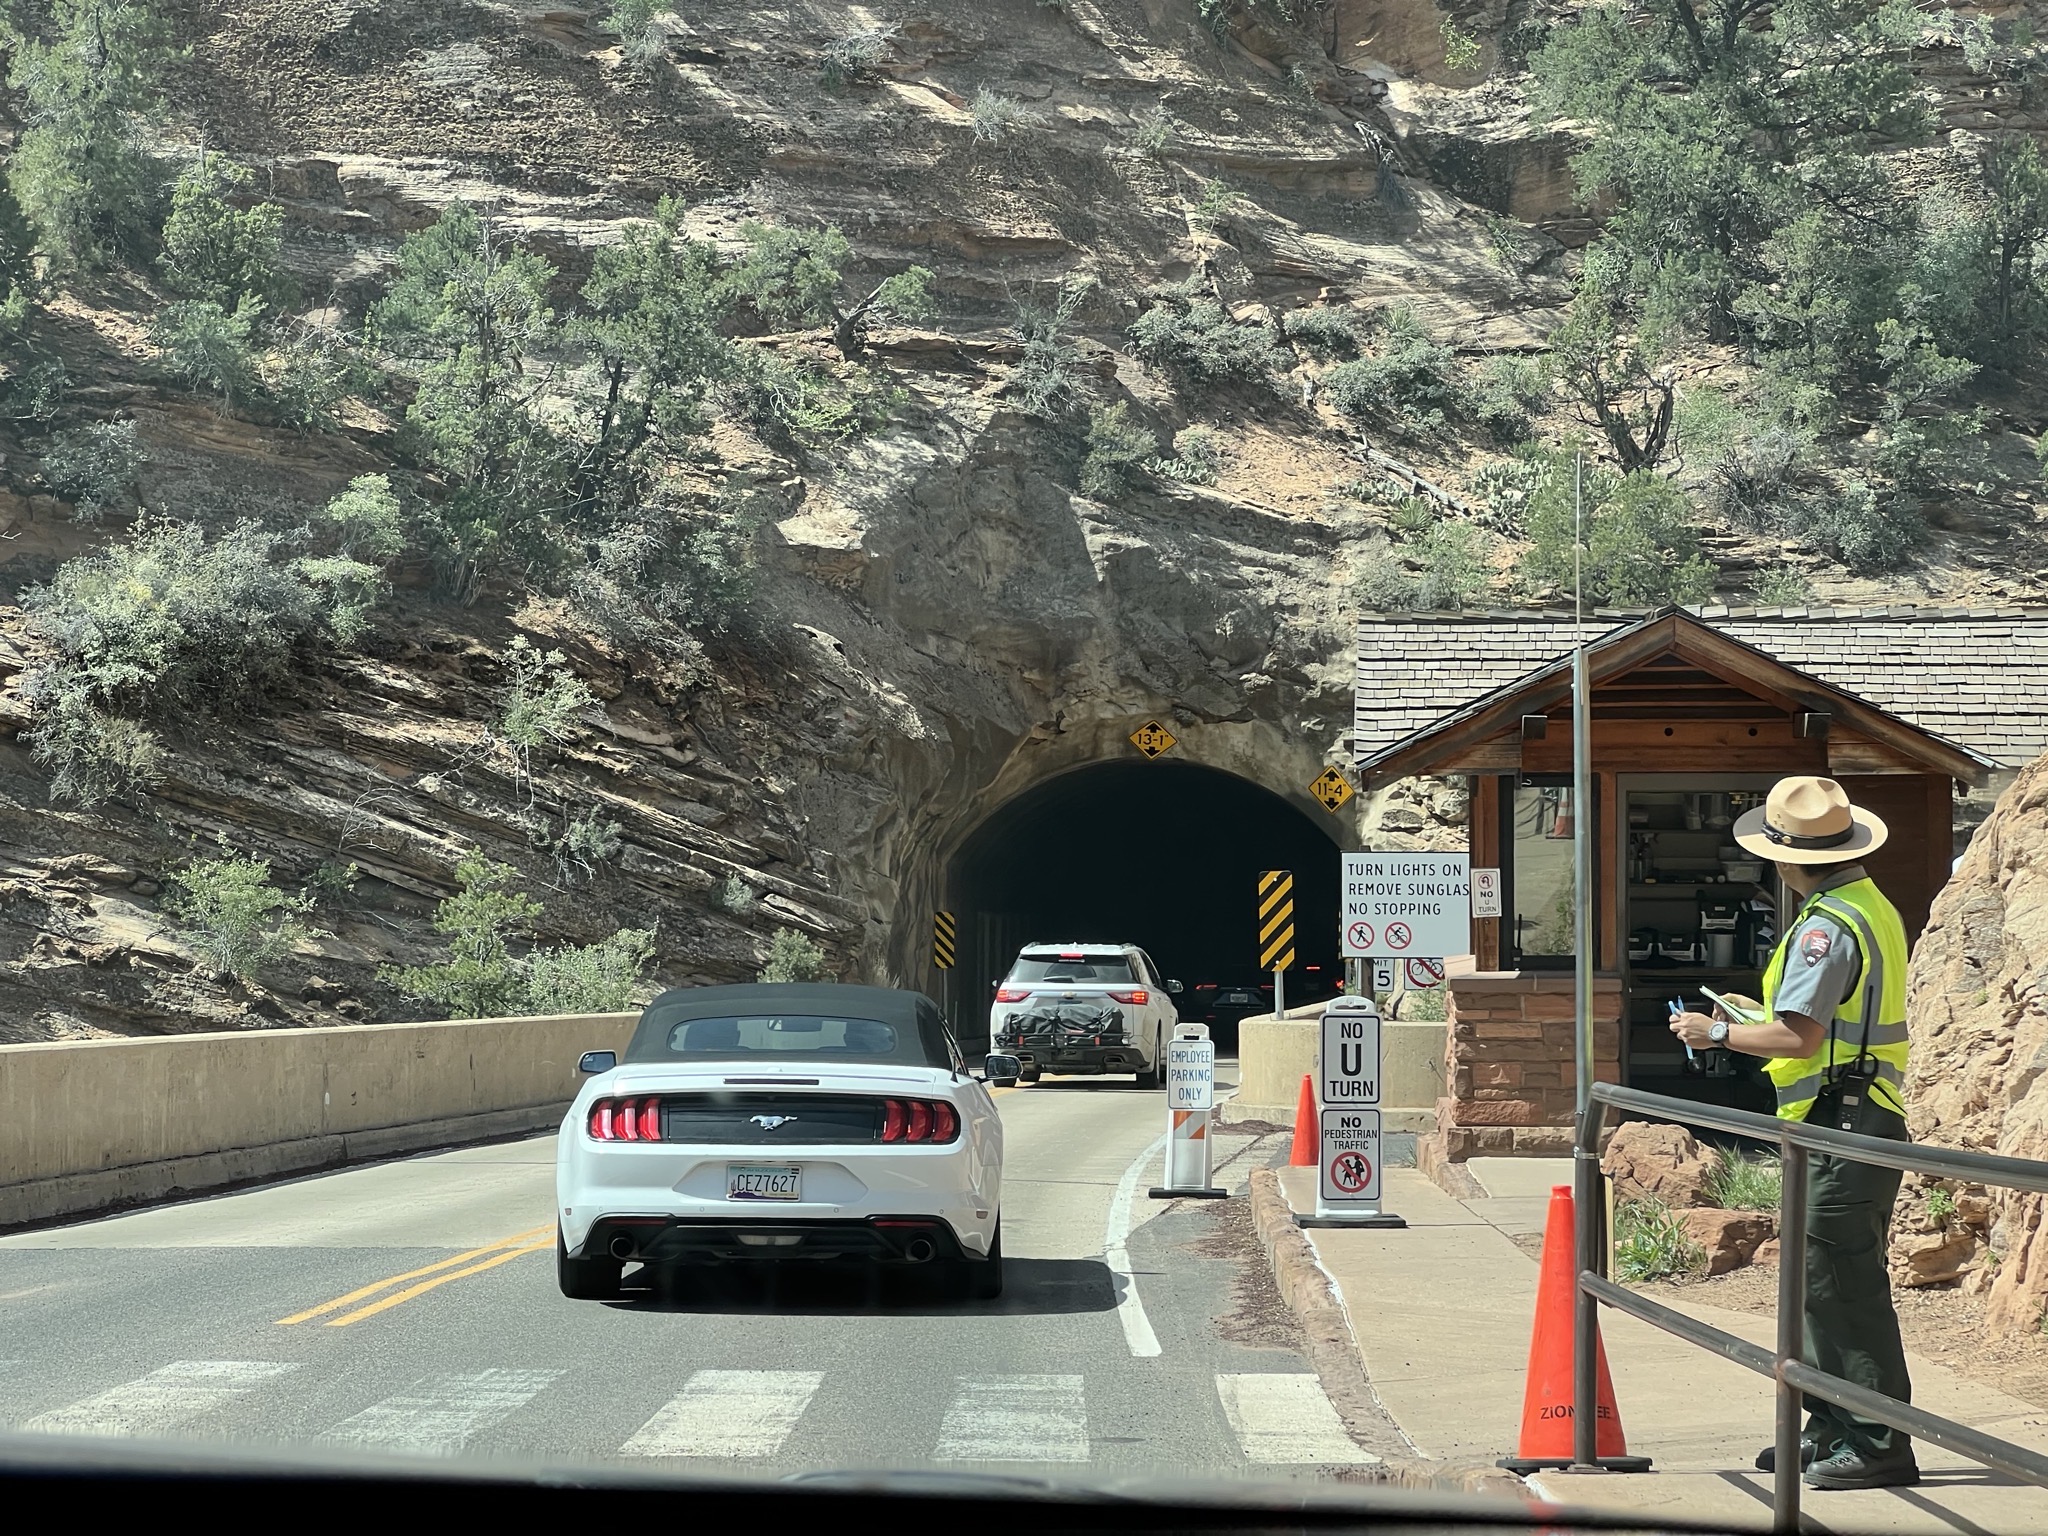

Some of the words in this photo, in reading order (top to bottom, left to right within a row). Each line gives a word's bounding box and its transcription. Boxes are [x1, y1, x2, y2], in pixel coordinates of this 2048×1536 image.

[1348, 863, 1383, 876] TURN
[1390, 863, 1436, 876] LIGHTS
[1442, 863, 1462, 876] ON
[1349, 883, 1402, 896] REMOVE
[1408, 883, 1470, 896] SUNGLAS
[1480, 890, 1494, 898] NO
[1349, 903, 1368, 915] NO
[1374, 903, 1441, 915] STOPPING
[1373, 959, 1388, 967] MIT
[1377, 970, 1391, 987] 5
[1341, 1022, 1363, 1039] NO
[1171, 1050, 1210, 1063] EMPLOYEE
[1341, 1043, 1362, 1077] U
[1171, 1069, 1210, 1082] PARKING
[1178, 1087, 1203, 1100] ONLY
[1329, 1081, 1374, 1097] TURN
[1341, 1117, 1362, 1128] NO
[1324, 1129, 1377, 1139] PEDESTRIAN
[1333, 1140, 1369, 1150] TRAFFIC
[737, 1174, 797, 1192] CEZ7627
[1597, 1405, 1611, 1419] EE
